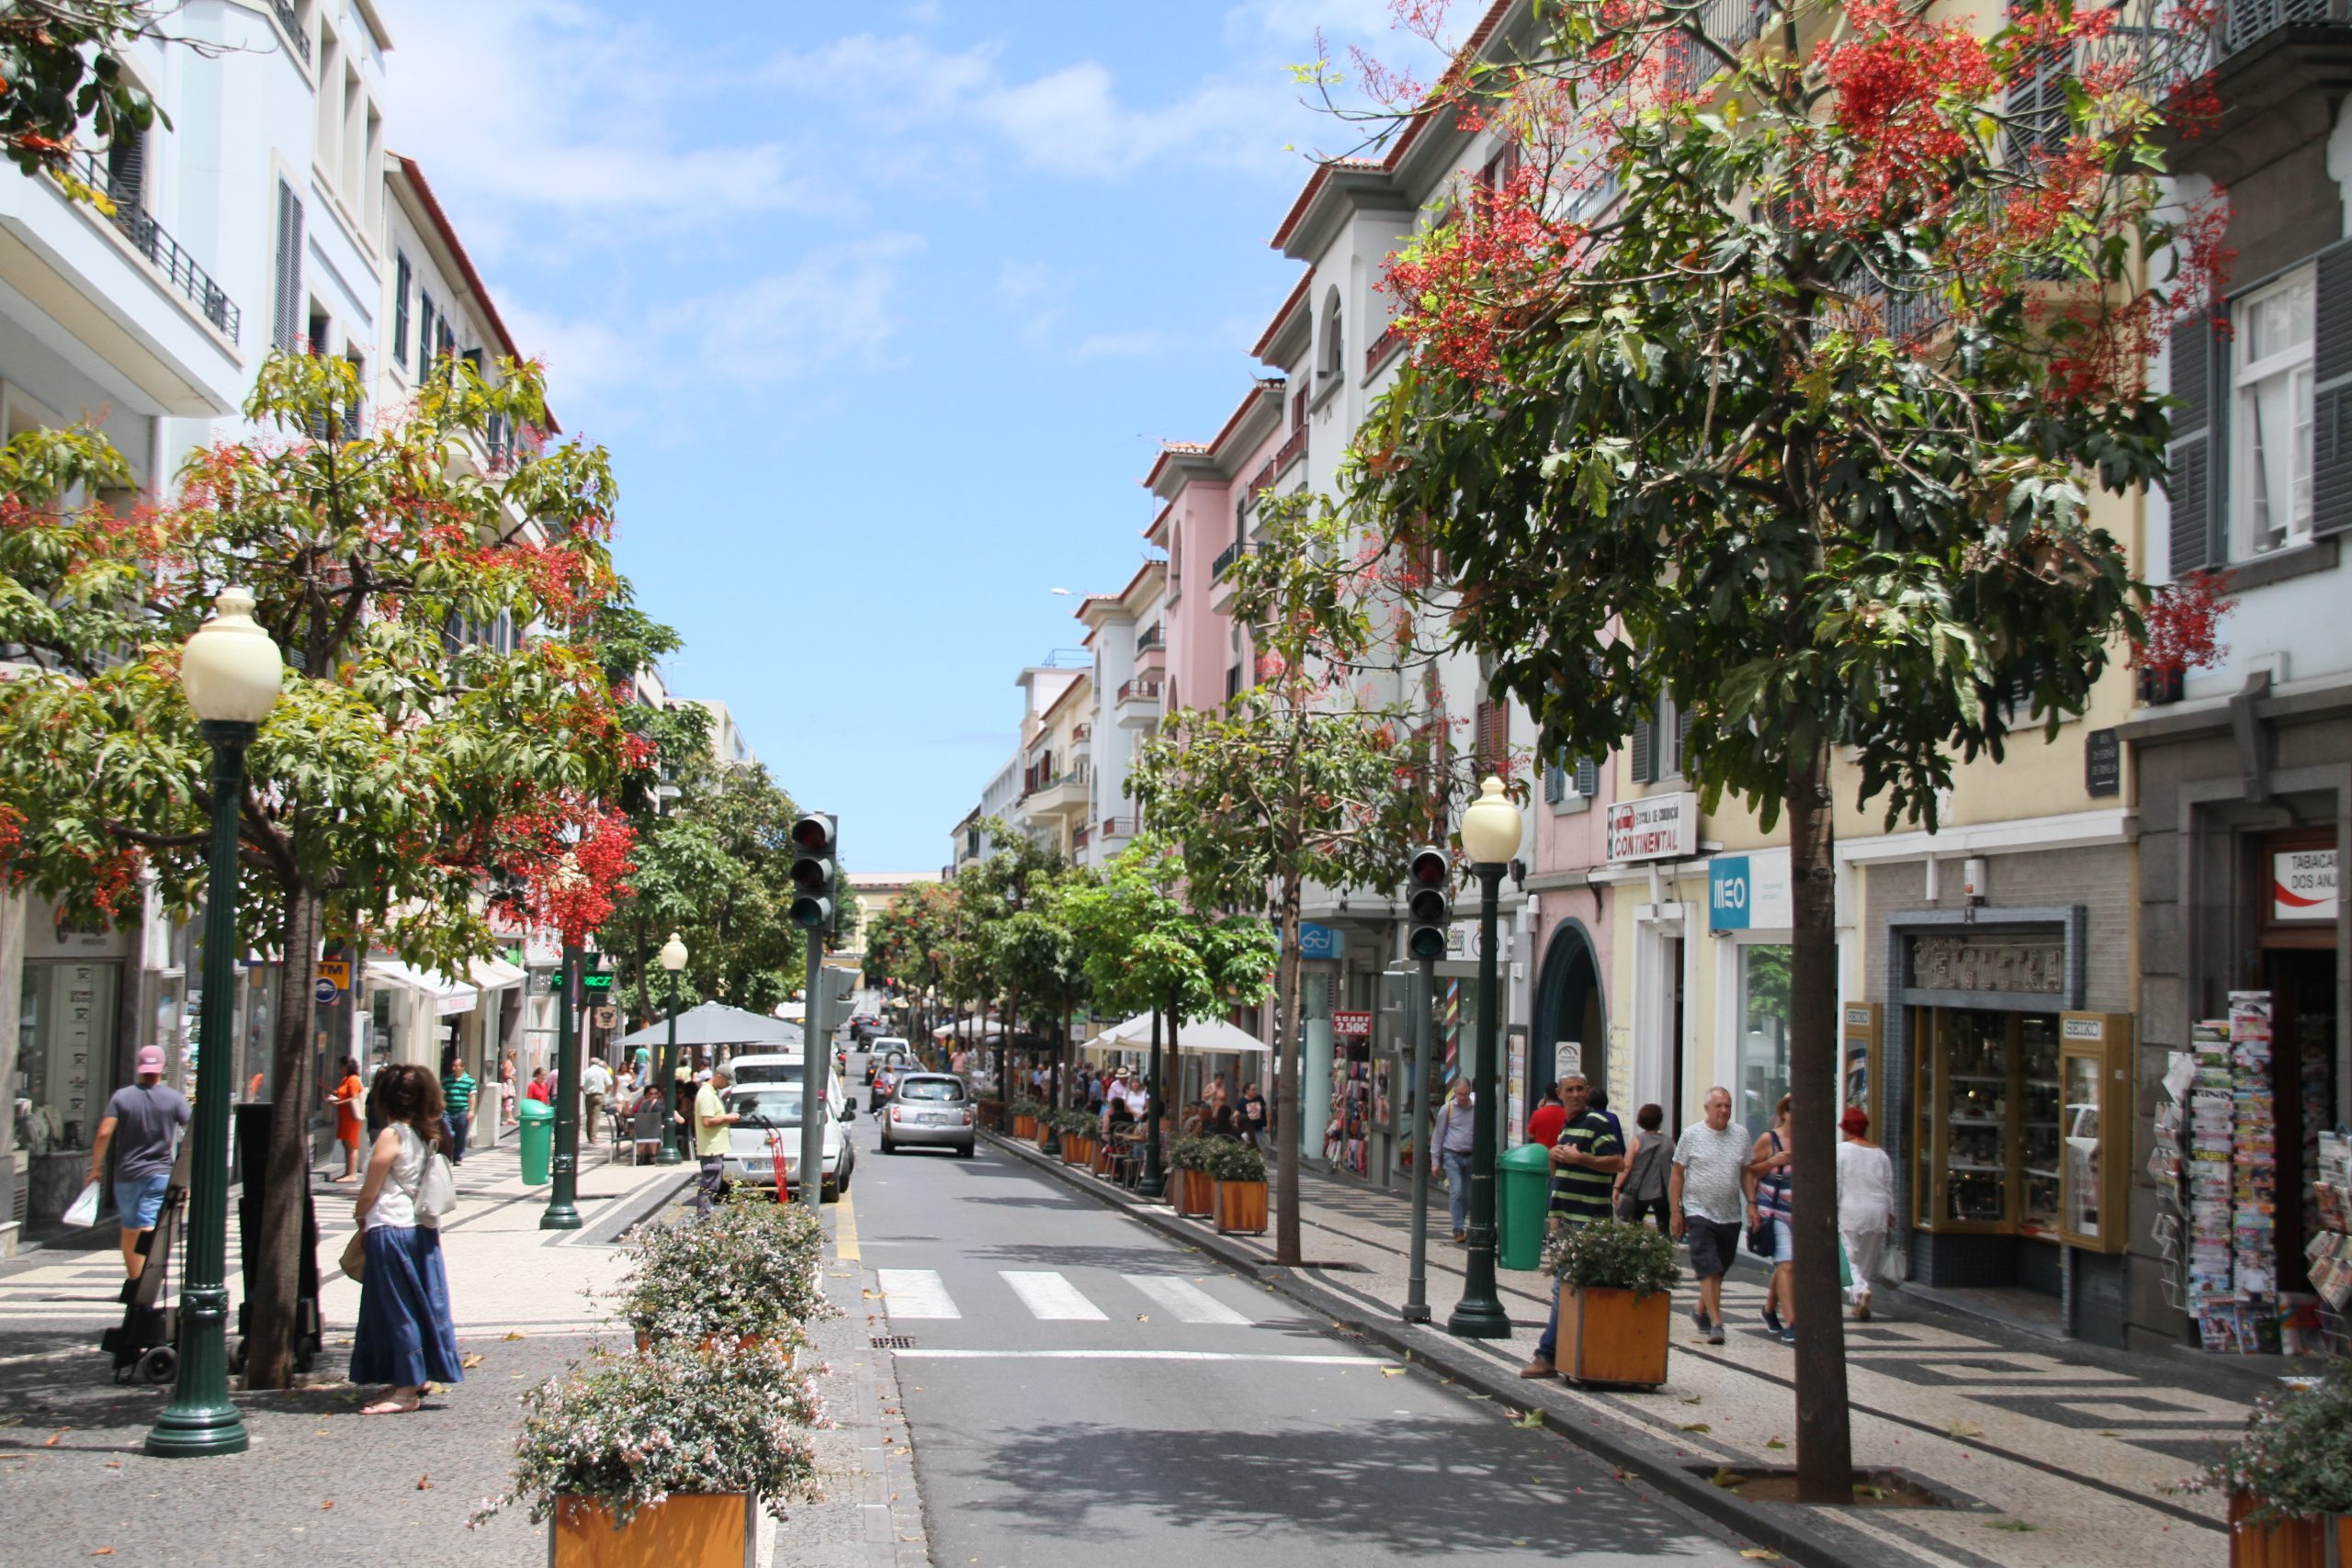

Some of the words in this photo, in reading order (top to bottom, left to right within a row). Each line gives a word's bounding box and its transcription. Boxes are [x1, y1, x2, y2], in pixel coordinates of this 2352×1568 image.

[1615, 830, 1678, 856] CONTINENTAL
[2292, 874, 2313, 888] DOS
[1713, 876, 1746, 909] MEO
[317, 964, 344, 975] TM
[1931, 949, 2062, 990] FIGUEIRA
[1336, 1021, 1368, 1033] 2,50€
[2066, 1021, 2098, 1036] SEIKO
